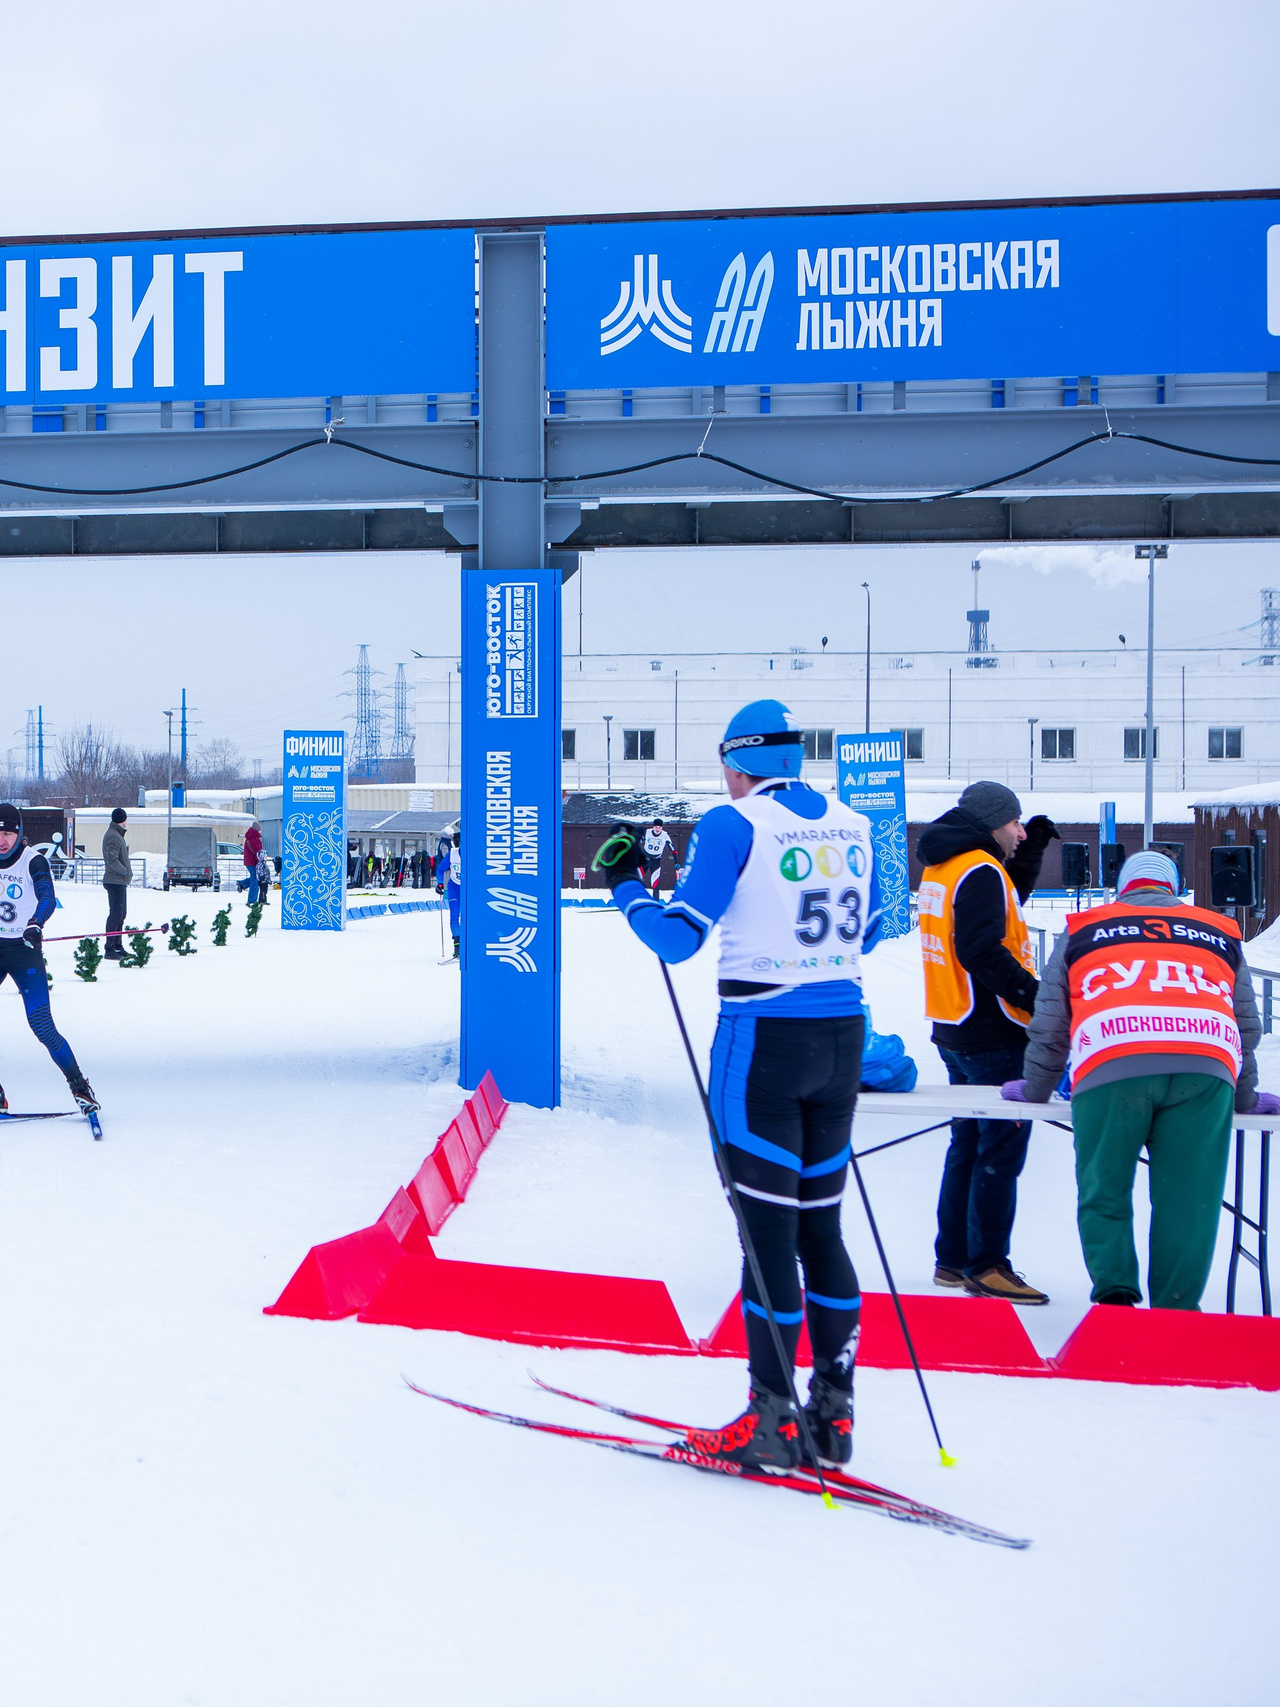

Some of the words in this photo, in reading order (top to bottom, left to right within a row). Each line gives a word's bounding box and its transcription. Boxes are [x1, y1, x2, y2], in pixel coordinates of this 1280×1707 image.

[797, 239, 1060, 296] МОСКОВСКАЯ
[796, 298, 943, 350] ЛЫЖНЯ
[486, 584, 501, 718] ЮГО-ВОСТОК
[286, 736, 342, 756] ФИНИШ
[722, 735, 765, 752] BRIKO
[841, 741, 900, 764] ФИНИШ
[486, 751, 511, 875] МОСКОВСКАЯ
[513, 806, 538, 876] ЛЫЖНЯ
[774, 829, 864, 845] VMARAFONE
[794, 887, 862, 947] 53
[1092, 924, 1141, 942] Arta
[1172, 924, 1228, 951] Sport
[1100, 1016, 1221, 1039] МОСКОВСКИЙ
[661, 1447, 742, 1475] ATOMIC
